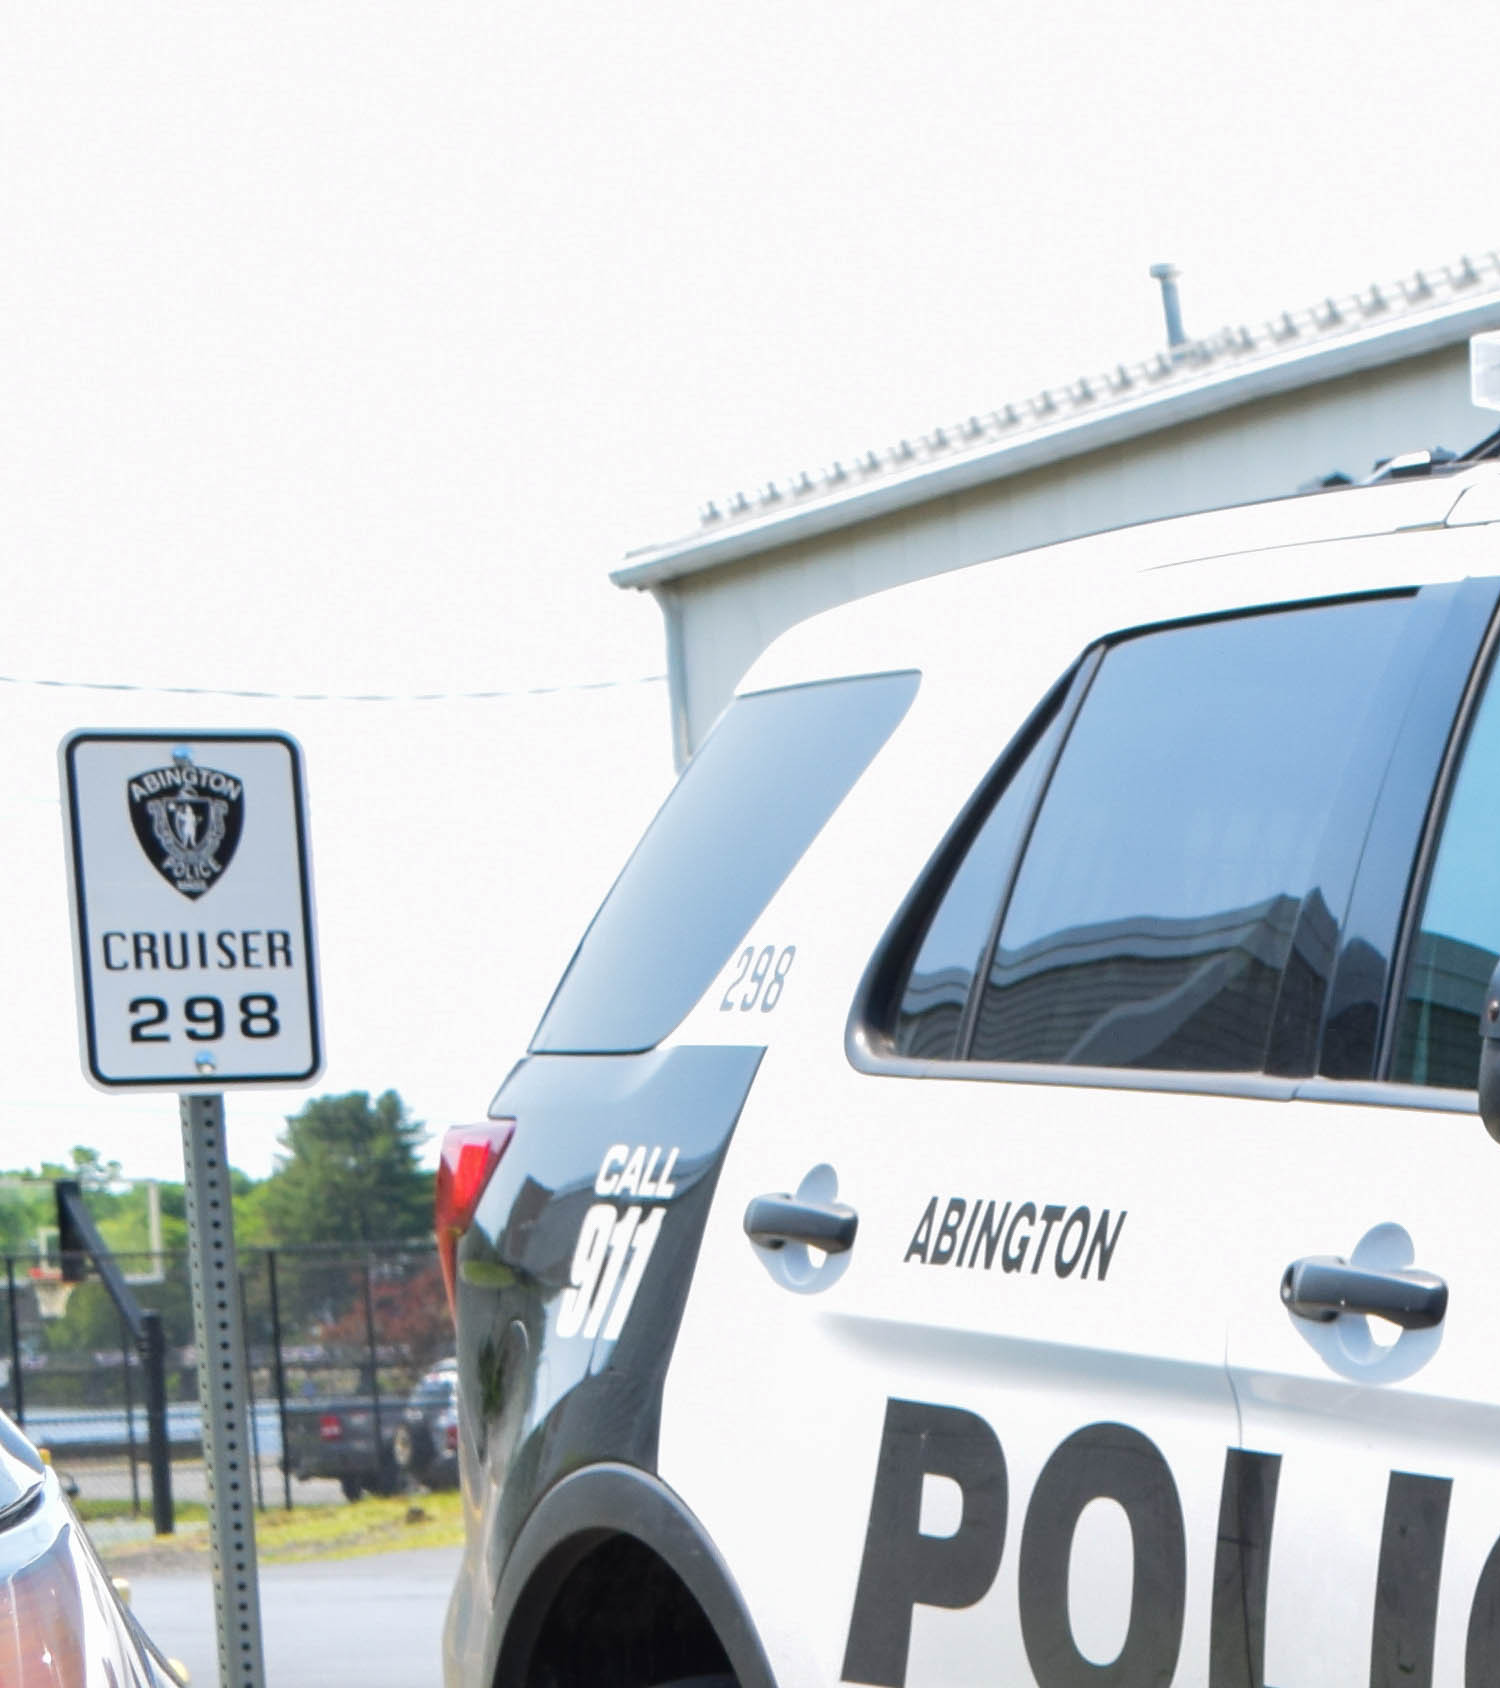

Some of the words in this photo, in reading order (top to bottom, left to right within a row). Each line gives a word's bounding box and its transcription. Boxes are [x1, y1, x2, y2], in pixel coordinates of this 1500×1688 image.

[131, 768, 241, 802] ABINGTON
[162, 855, 222, 881] POLICE
[102, 931, 293, 970] CRUISER
[718, 944, 797, 1013] 298
[129, 994, 280, 1042] 298
[594, 1144, 682, 1198] CALL
[904, 1196, 1127, 1282] ABINGTON
[554, 1202, 668, 1342] 911
